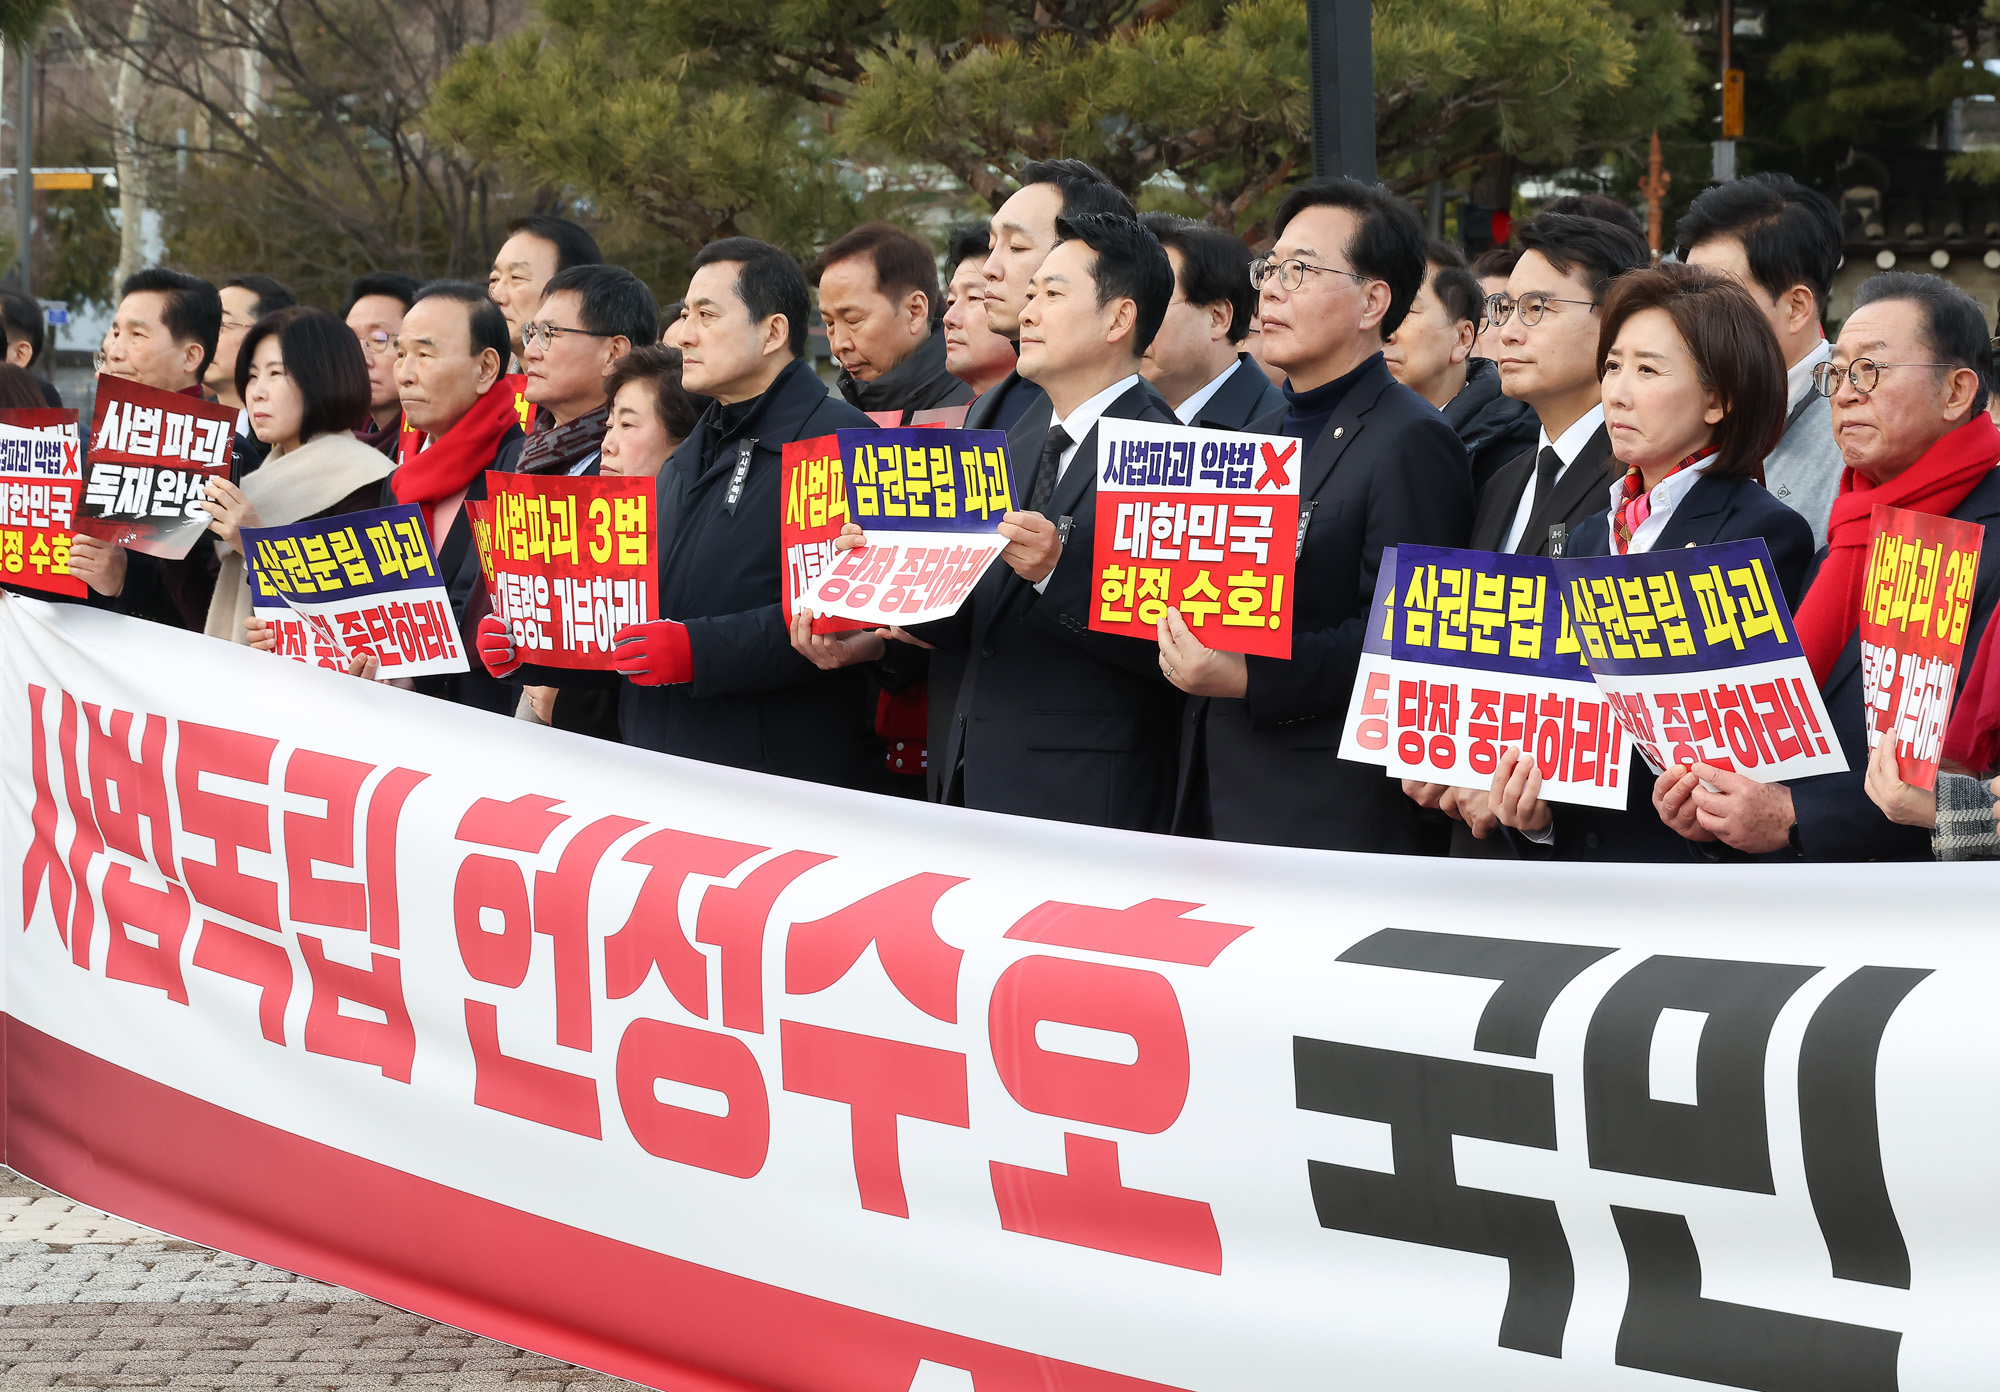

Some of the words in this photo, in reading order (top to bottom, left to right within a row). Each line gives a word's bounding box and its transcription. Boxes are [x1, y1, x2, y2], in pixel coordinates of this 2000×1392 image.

[35, 440, 61, 475] 악법
[786, 456, 851, 530] 사법파
[852, 445, 957, 518] 삼권분립
[960, 446, 1013, 520] 파괴
[1103, 440, 1195, 487] 사법파괴
[1200, 442, 1256, 488] 악법
[0, 529, 24, 574] 정
[29, 532, 76, 575] 수호
[255, 527, 374, 593] 삼권분립
[365, 516, 435, 580] 파괴
[494, 491, 579, 565] 사법파괴
[588, 495, 647, 565] 3법
[1112, 501, 1274, 564] 대한민국
[496, 571, 554, 650] 대통령은
[818, 545, 898, 608] 당장
[878, 545, 998, 614] 중단하라!
[1099, 564, 1171, 625] 헌정
[1180, 568, 1286, 630] 수호!
[1402, 564, 1547, 660] 삼권분립
[1570, 570, 1697, 660] 삼권분립
[1688, 558, 1789, 651] 파괴
[1862, 531, 1943, 638] 사법파괴
[1936, 549, 1978, 646] 3법
[334, 600, 458, 667] 중단하라!
[1397, 680, 1460, 770] 당장
[1468, 688, 1626, 788] 중단하라!
[1653, 677, 1832, 774] 중단하라!
[22, 683, 432, 1085] 사법독립
[453, 793, 1256, 1277] 헌정수호
[1292, 927, 1938, 1392] 국민
